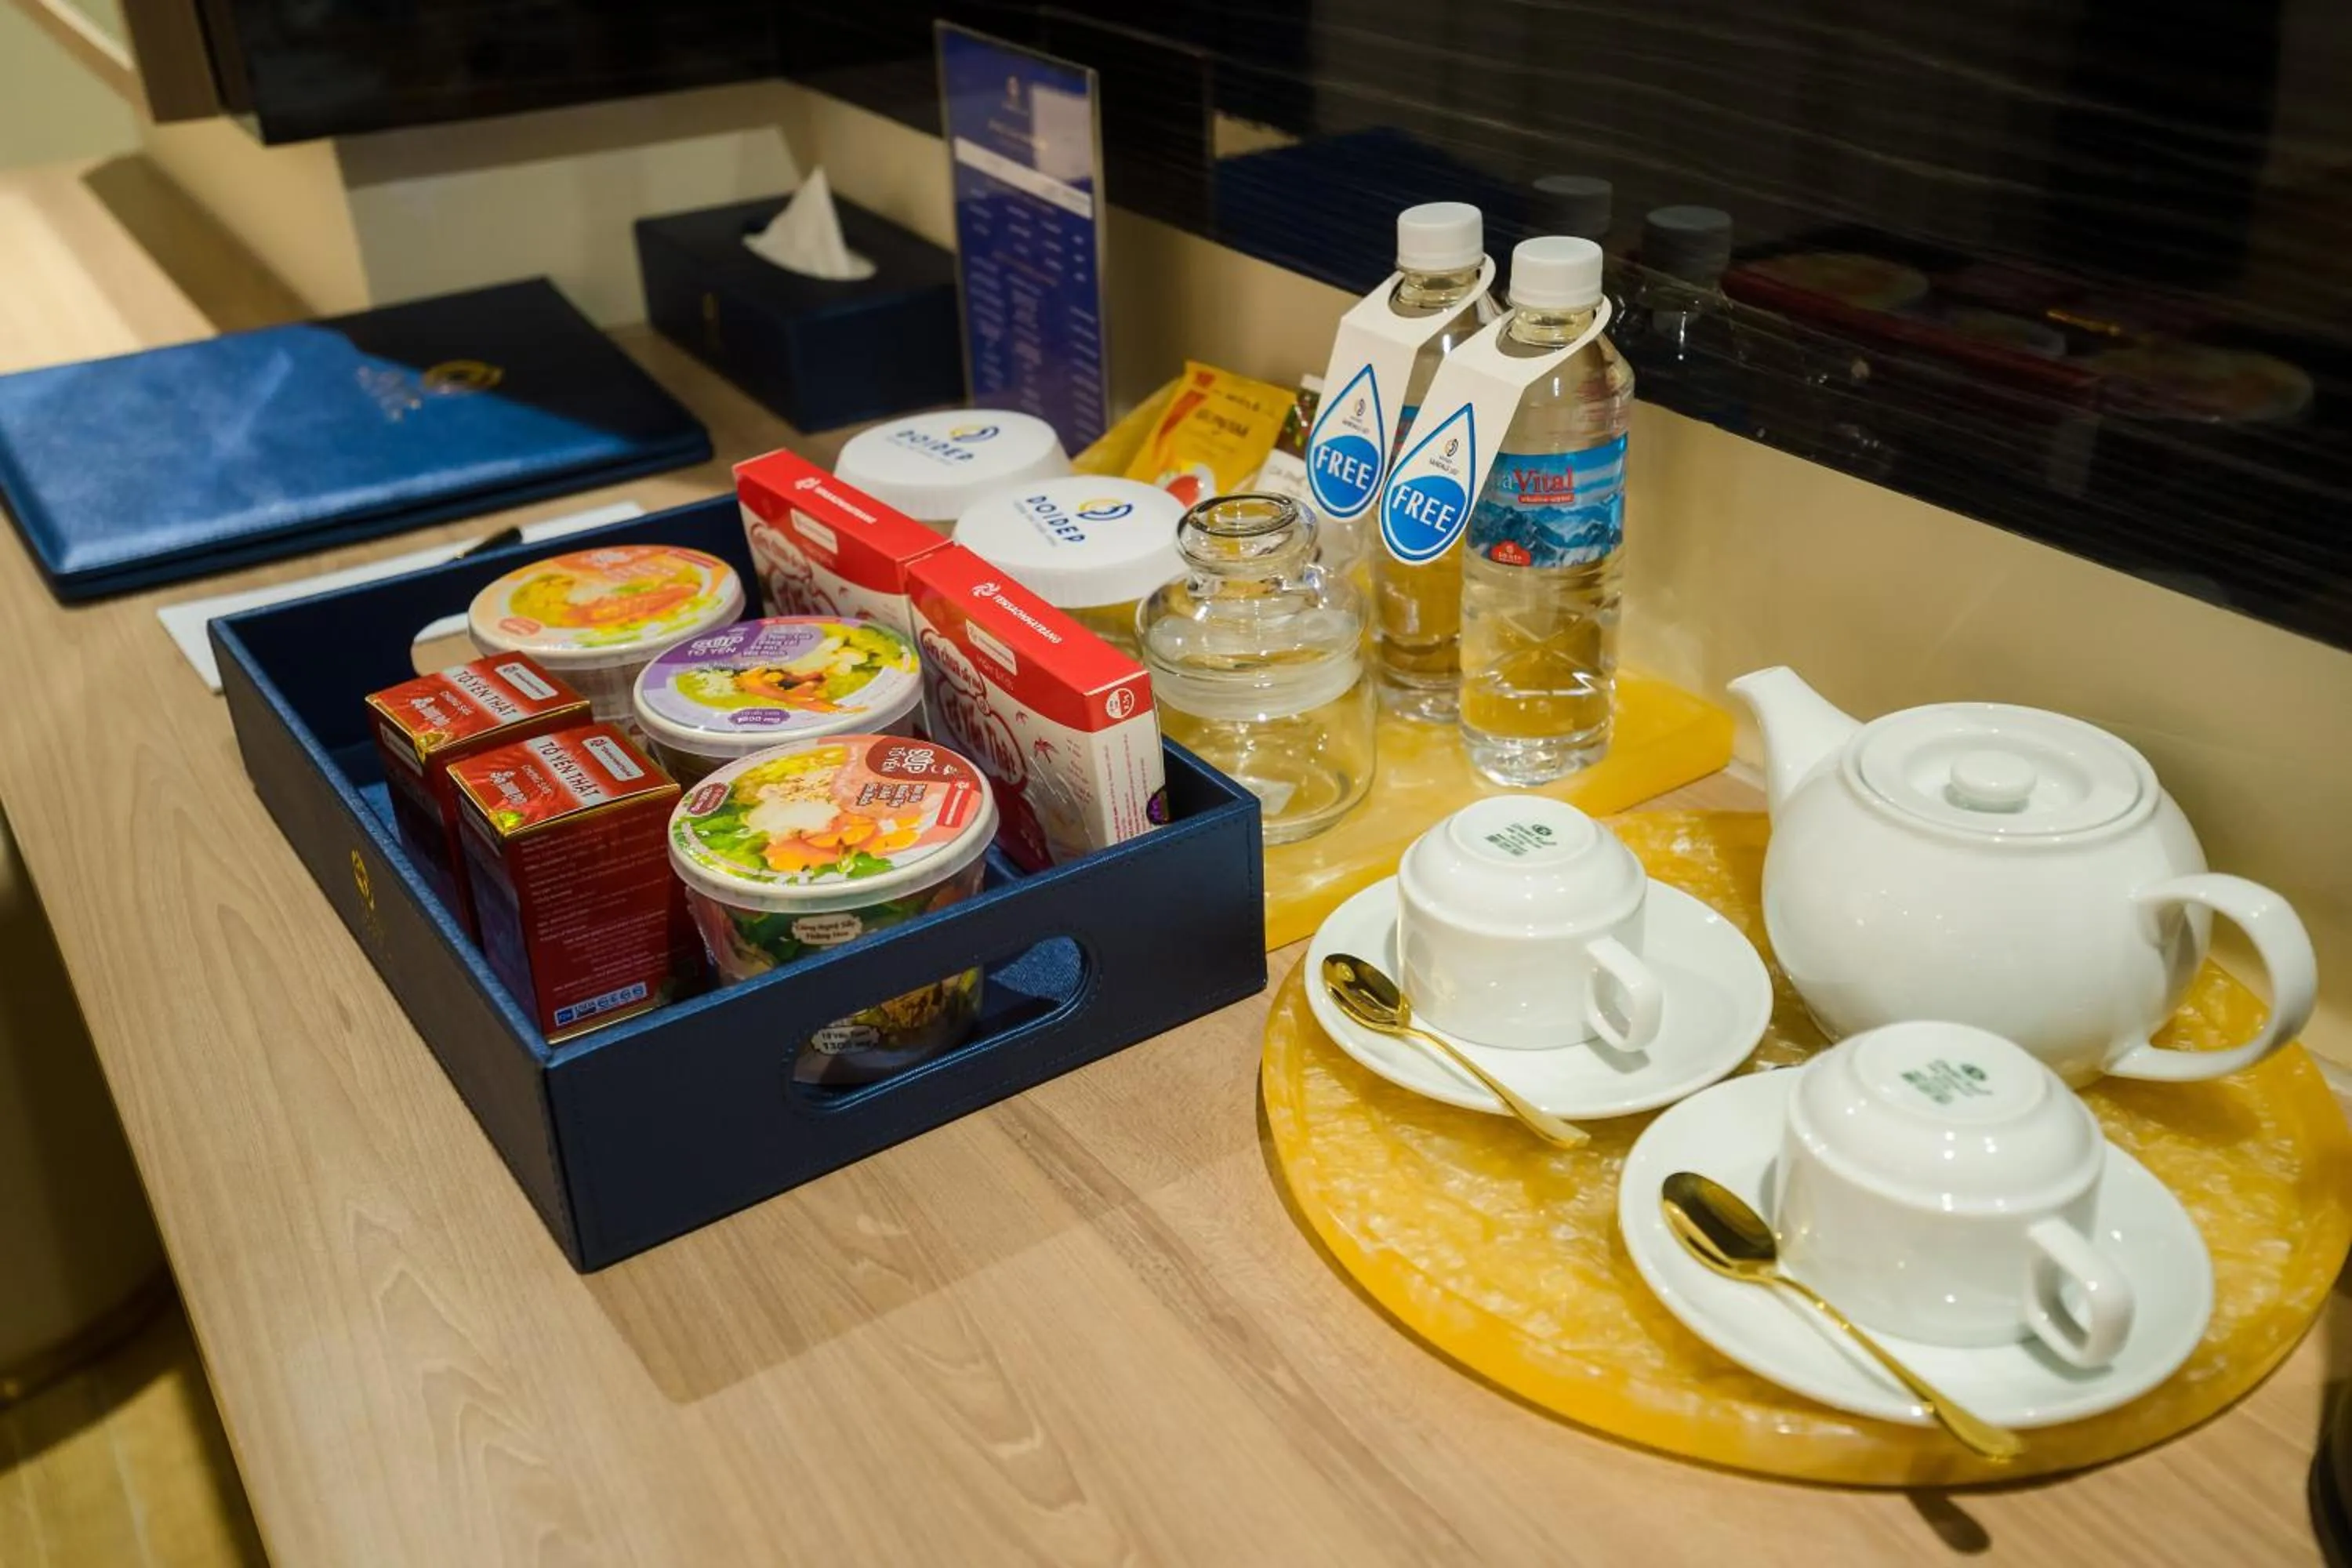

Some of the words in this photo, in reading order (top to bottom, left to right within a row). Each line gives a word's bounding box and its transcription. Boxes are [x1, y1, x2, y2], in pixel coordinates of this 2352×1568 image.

[1316, 445, 1373, 490] FREE
[1513, 465, 1573, 493] Vital
[1025, 495, 1087, 543] DOIDEP
[1392, 485, 1456, 533] FREE
[902, 749, 935, 774] SÚP
